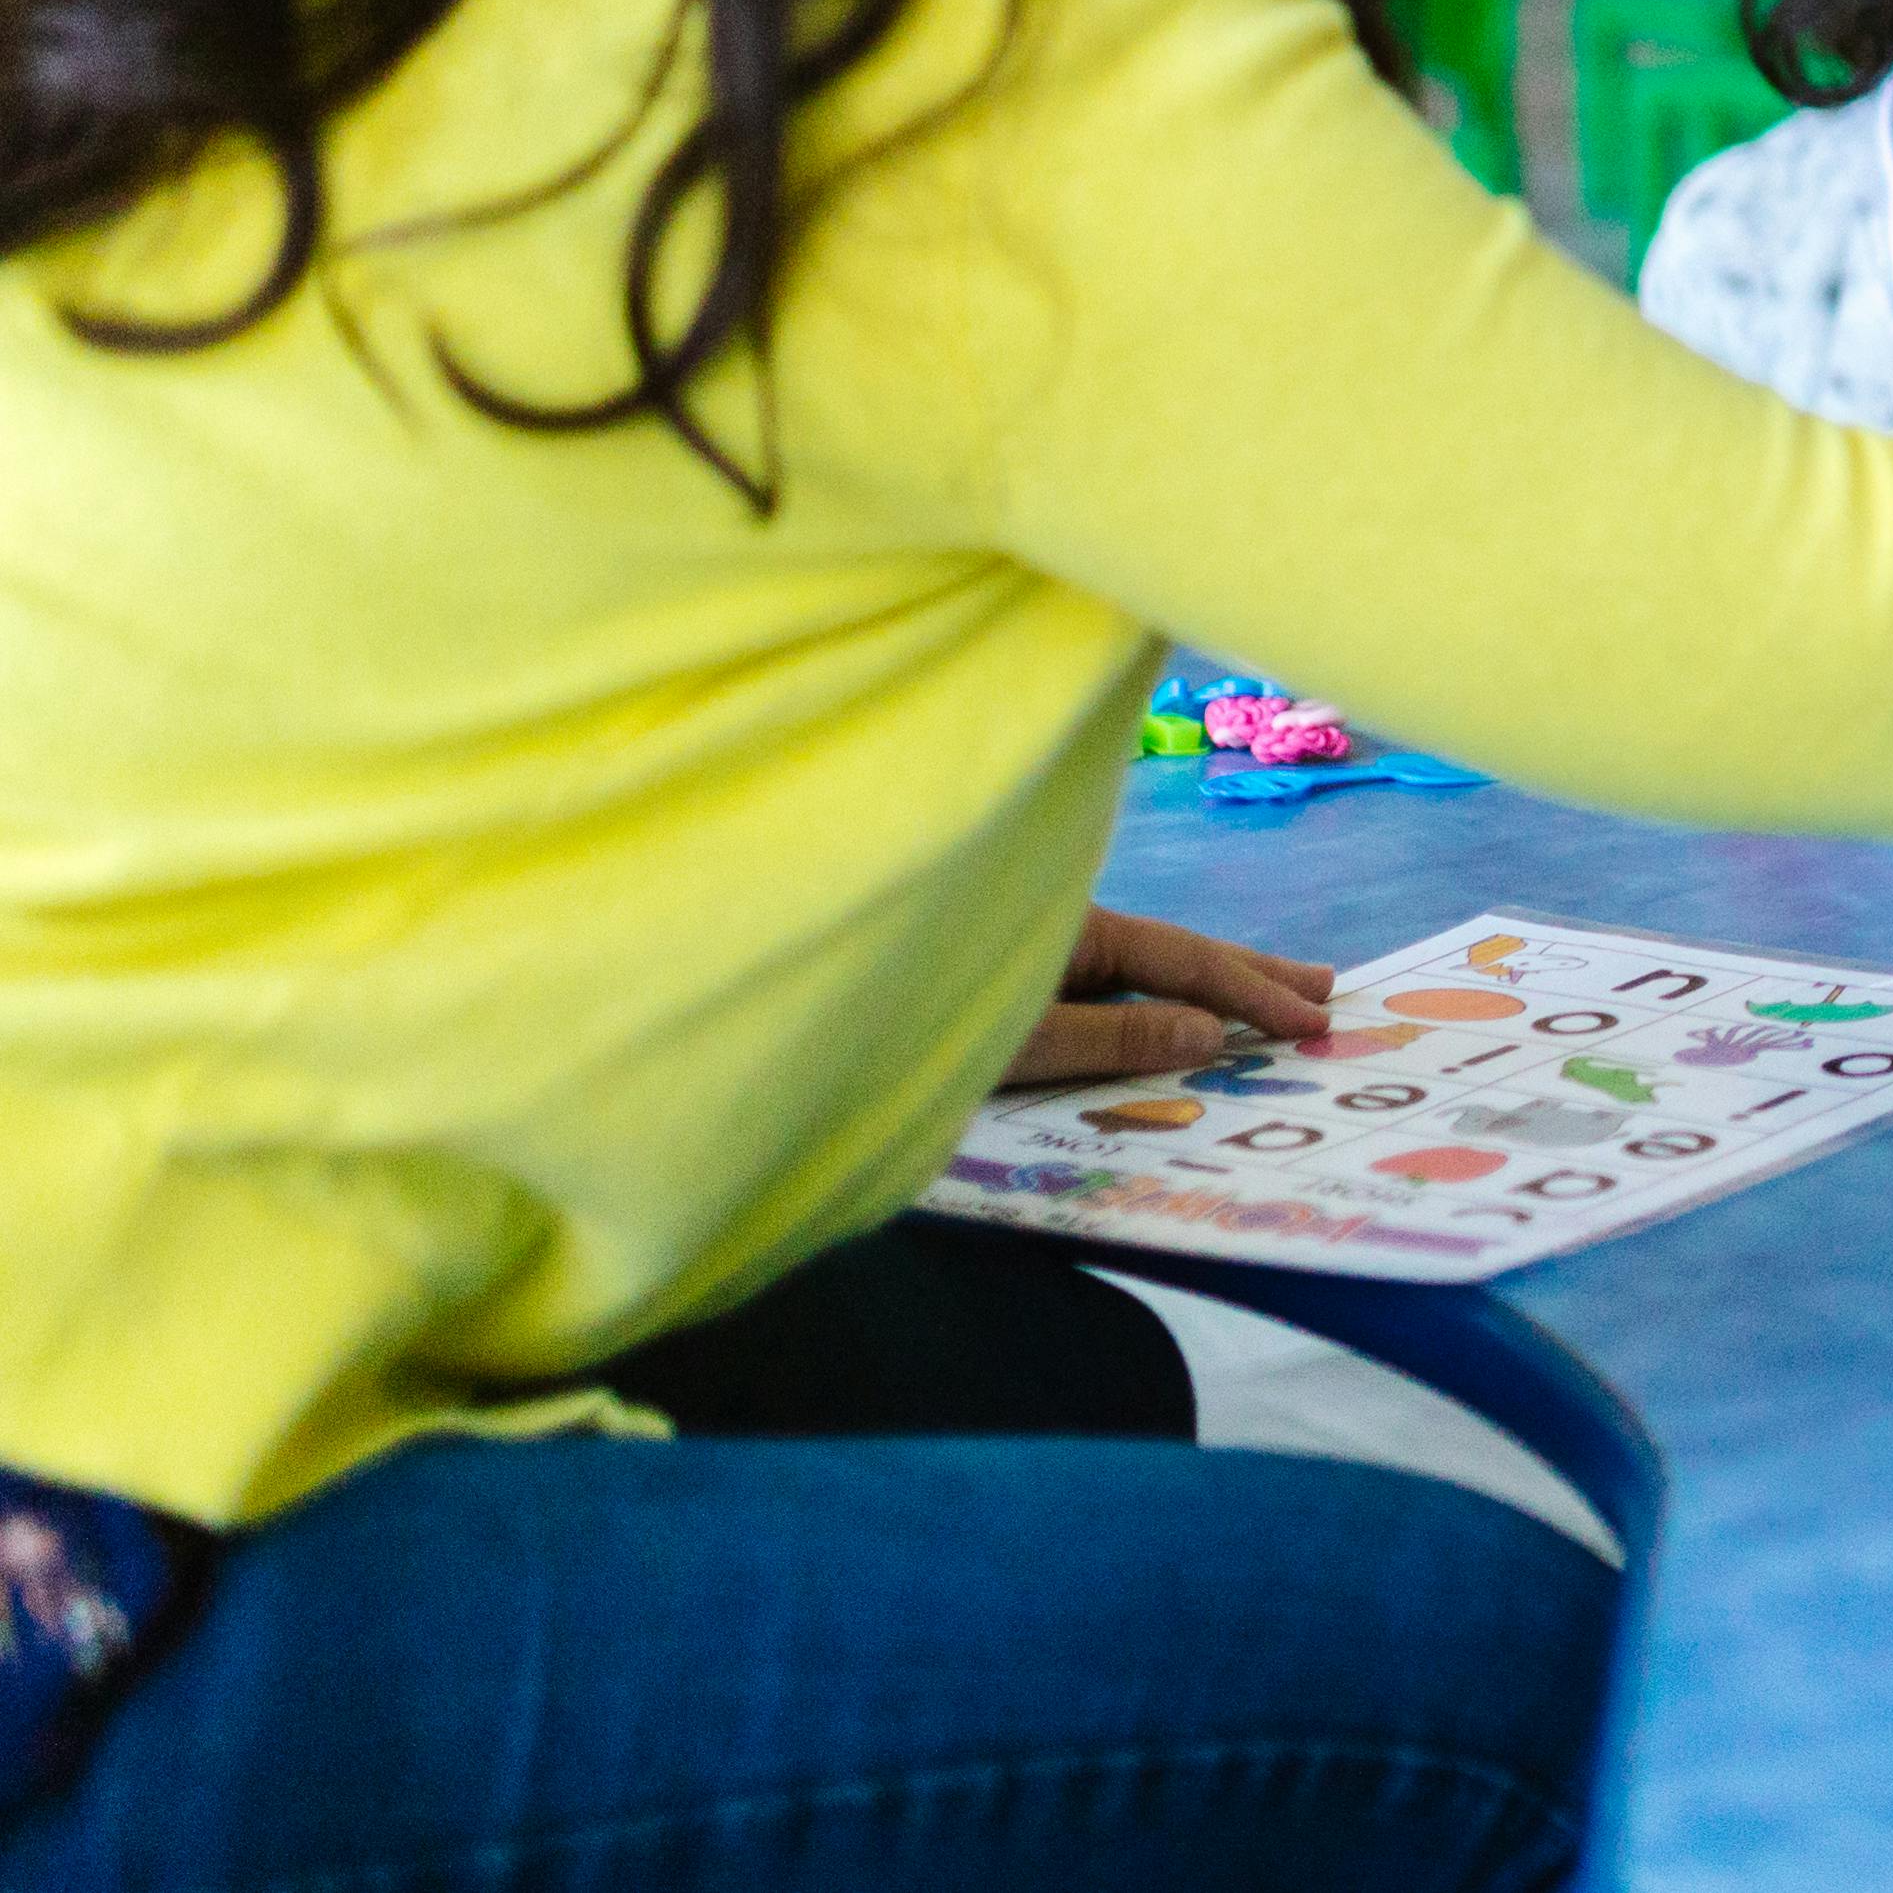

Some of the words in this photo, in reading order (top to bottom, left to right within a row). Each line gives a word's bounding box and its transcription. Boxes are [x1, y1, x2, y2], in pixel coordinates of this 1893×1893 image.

[1610, 969, 1709, 1001] u
[1531, 1010, 1620, 1036] o
[1440, 1044, 1522, 1074] i
[1333, 1083, 1428, 1112] e
[1728, 1090, 1809, 1121] i
[1017, 1131, 1125, 1157] LONG
[1215, 1120, 1324, 1151] a
[1622, 1130, 1717, 1160] e
[1505, 1168, 1617, 1200] a
